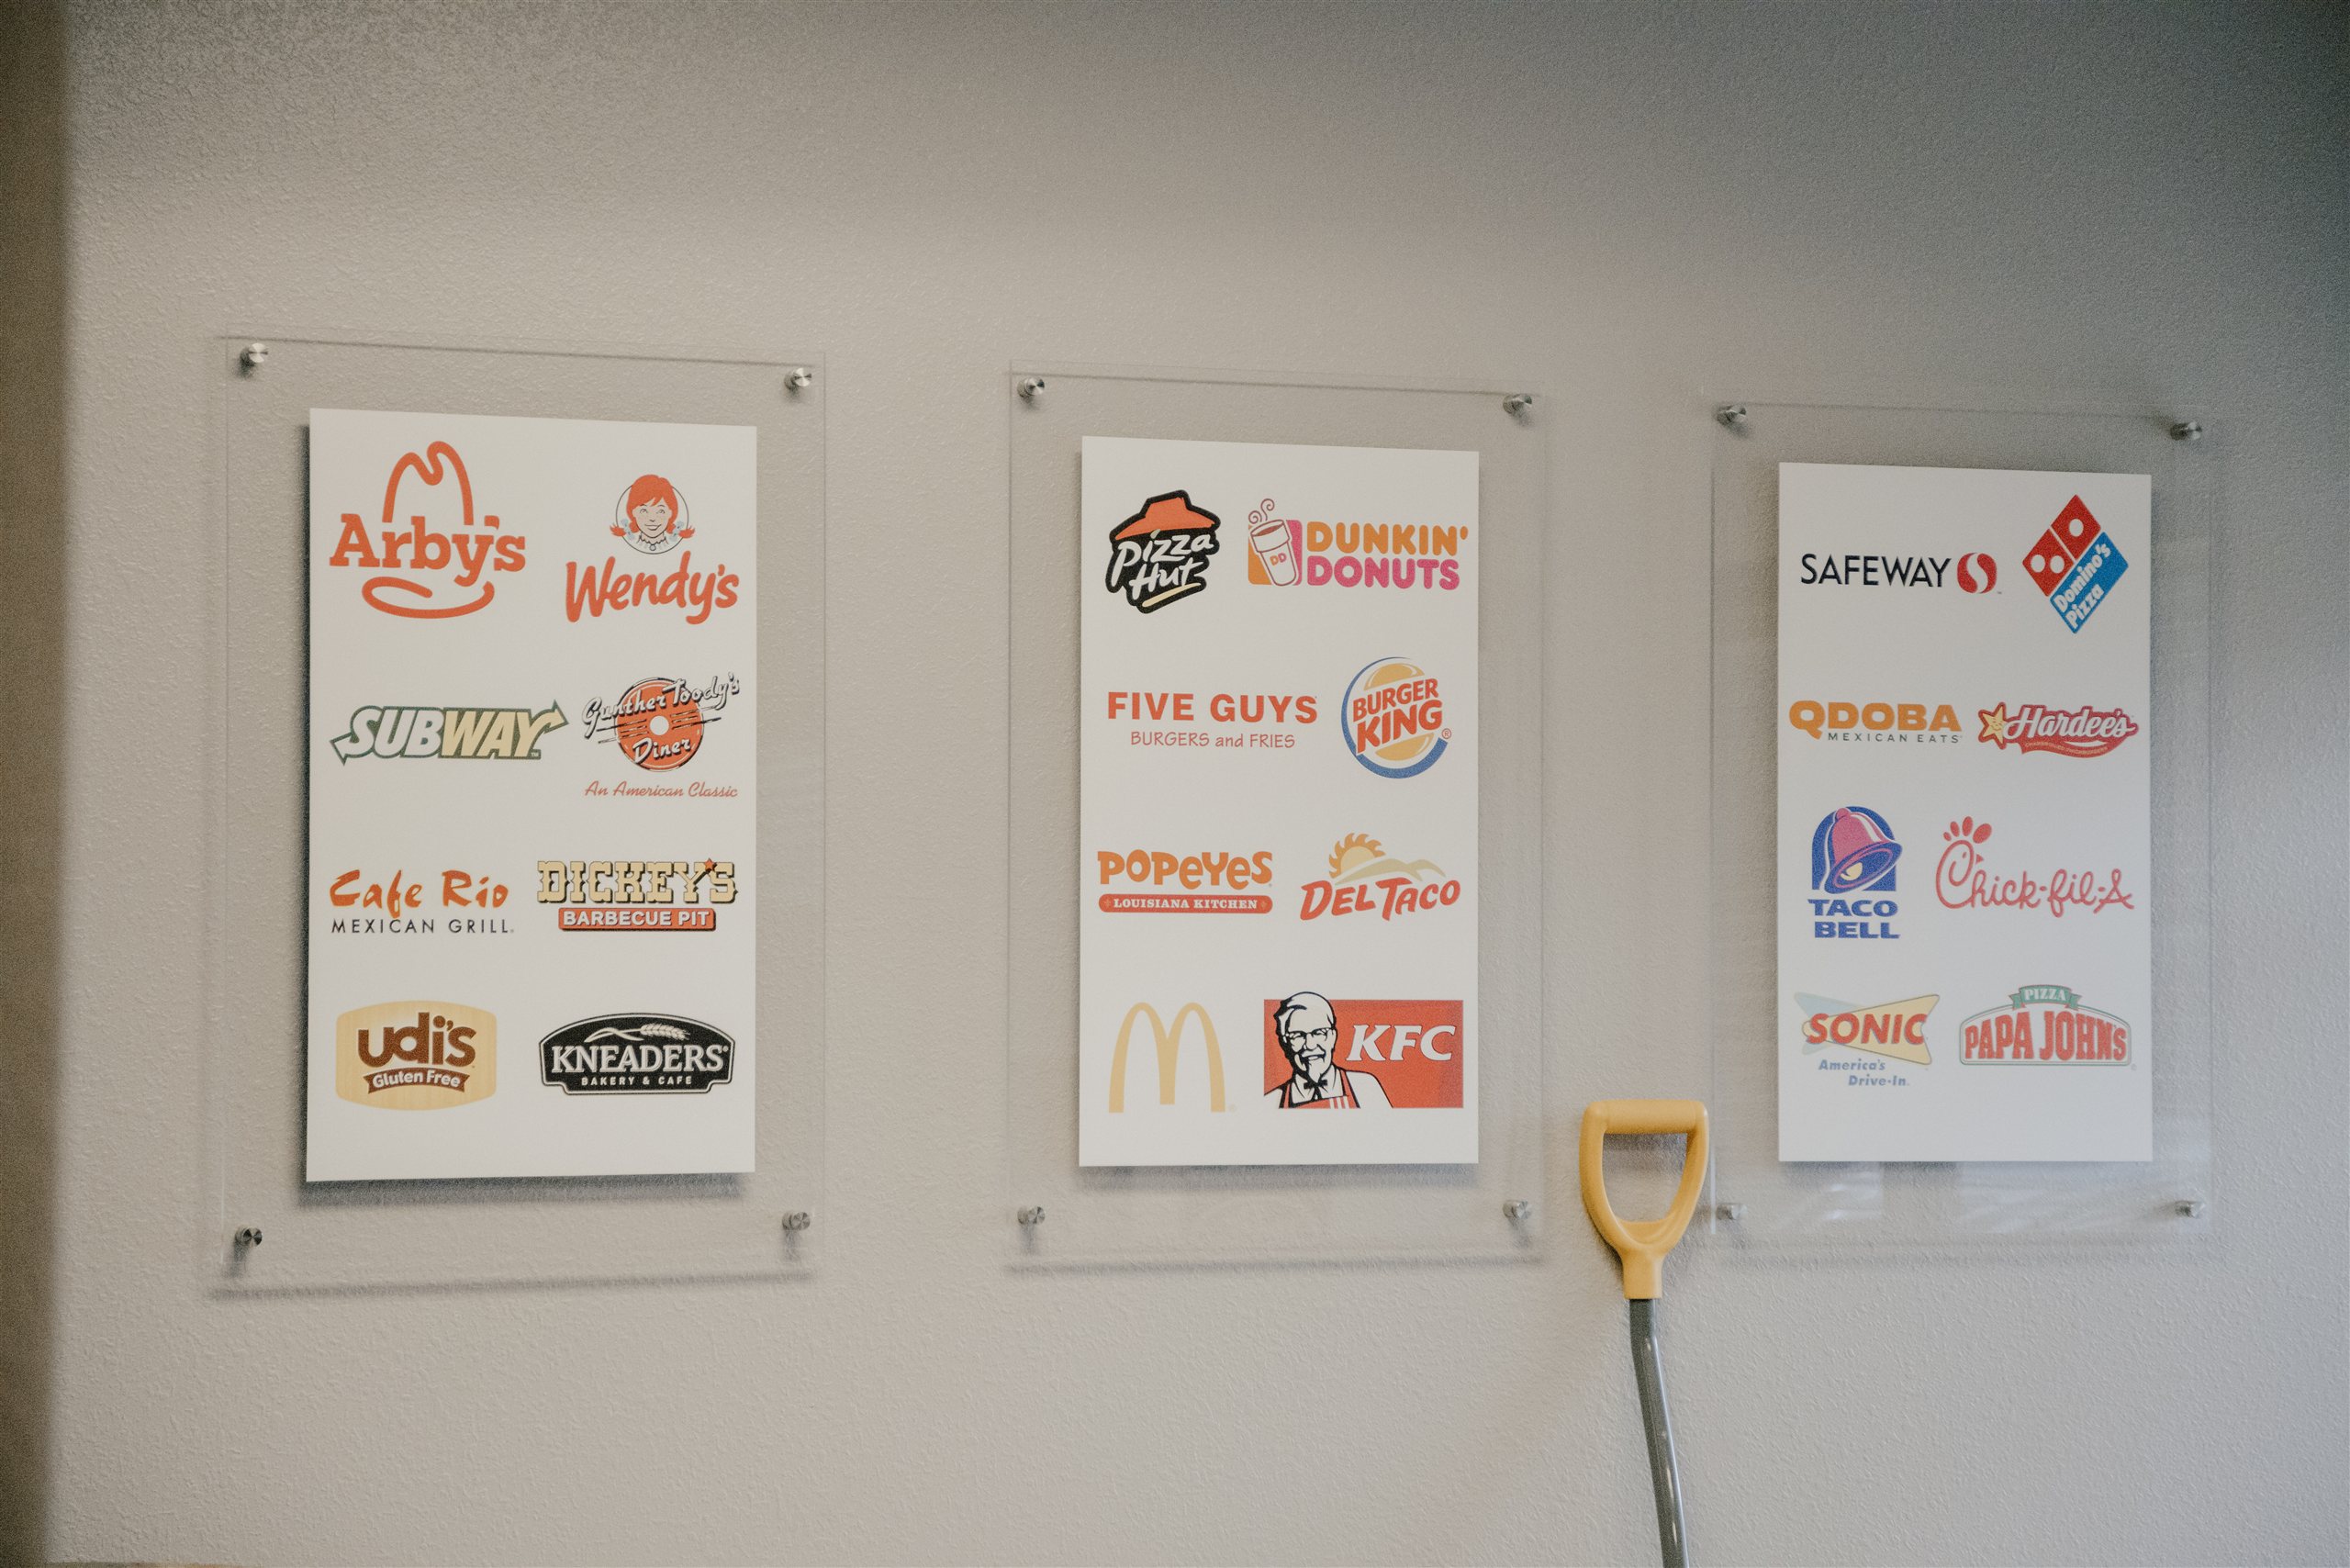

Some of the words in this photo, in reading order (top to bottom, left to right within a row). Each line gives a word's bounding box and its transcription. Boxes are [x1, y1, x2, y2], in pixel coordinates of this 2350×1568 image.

[330, 512, 526, 587] Arby's
[1307, 521, 1468, 556] DUNKIN'
[1111, 529, 1214, 587] Pizza
[1270, 553, 1287, 566] DD
[1307, 555, 1460, 590] DONUTS
[1800, 553, 1952, 588] SAFEWAY
[565, 550, 740, 625] Wendy's
[1129, 557, 1203, 600] Hut
[2053, 543, 2111, 613] Domino's
[2065, 584, 2105, 629] Pizza
[581, 689, 666, 739] Gunther
[662, 671, 740, 711] Toody's
[1108, 691, 1194, 722] FIVE
[1210, 693, 1317, 724] GUYS
[1353, 678, 1439, 722] BURGER
[330, 700, 569, 766] SUBWAY
[1357, 700, 1442, 754] KING
[1788, 700, 1963, 740] QDOBA
[2002, 707, 2136, 740] Hardee's
[632, 737, 692, 765] Diner
[1130, 731, 1210, 746] BURGERS
[1214, 734, 1244, 748] and
[1249, 734, 1295, 748] FRIES
[1828, 733, 1908, 743] MEXICAN
[1917, 734, 1959, 744] EATS
[585, 780, 609, 797] An
[612, 780, 685, 798] American
[688, 782, 738, 798] Classic
[329, 869, 422, 919] Cafe
[1935, 839, 2135, 918] Chick-fil-A
[1113, 898, 1190, 909] LOUISIANA
[1193, 899, 1258, 909] KITCHEN
[1300, 879, 1377, 921] DEL
[1375, 877, 1460, 921] TACO
[1807, 898, 1899, 917] TACO
[331, 919, 435, 933] MEXICAN
[448, 919, 509, 933] GRILL
[563, 910, 673, 926] BARBECUE
[677, 910, 710, 926] PIT
[1814, 921, 1901, 939] BELL
[2023, 988, 2066, 1001] PIZZA
[358, 1012, 476, 1067] udi's
[1345, 1024, 1457, 1062] KFC
[1806, 1013, 1927, 1045] SONIC
[1964, 1011, 2034, 1059] PAPA
[551, 1045, 724, 1073] KNEADERS
[1818, 1058, 1886, 1071] America's
[372, 1070, 423, 1088] Gluten
[426, 1070, 460, 1088] Free
[581, 1075, 636, 1086] BAKERY
[642, 1076, 650, 1085] &
[658, 1075, 692, 1085] CAFE
